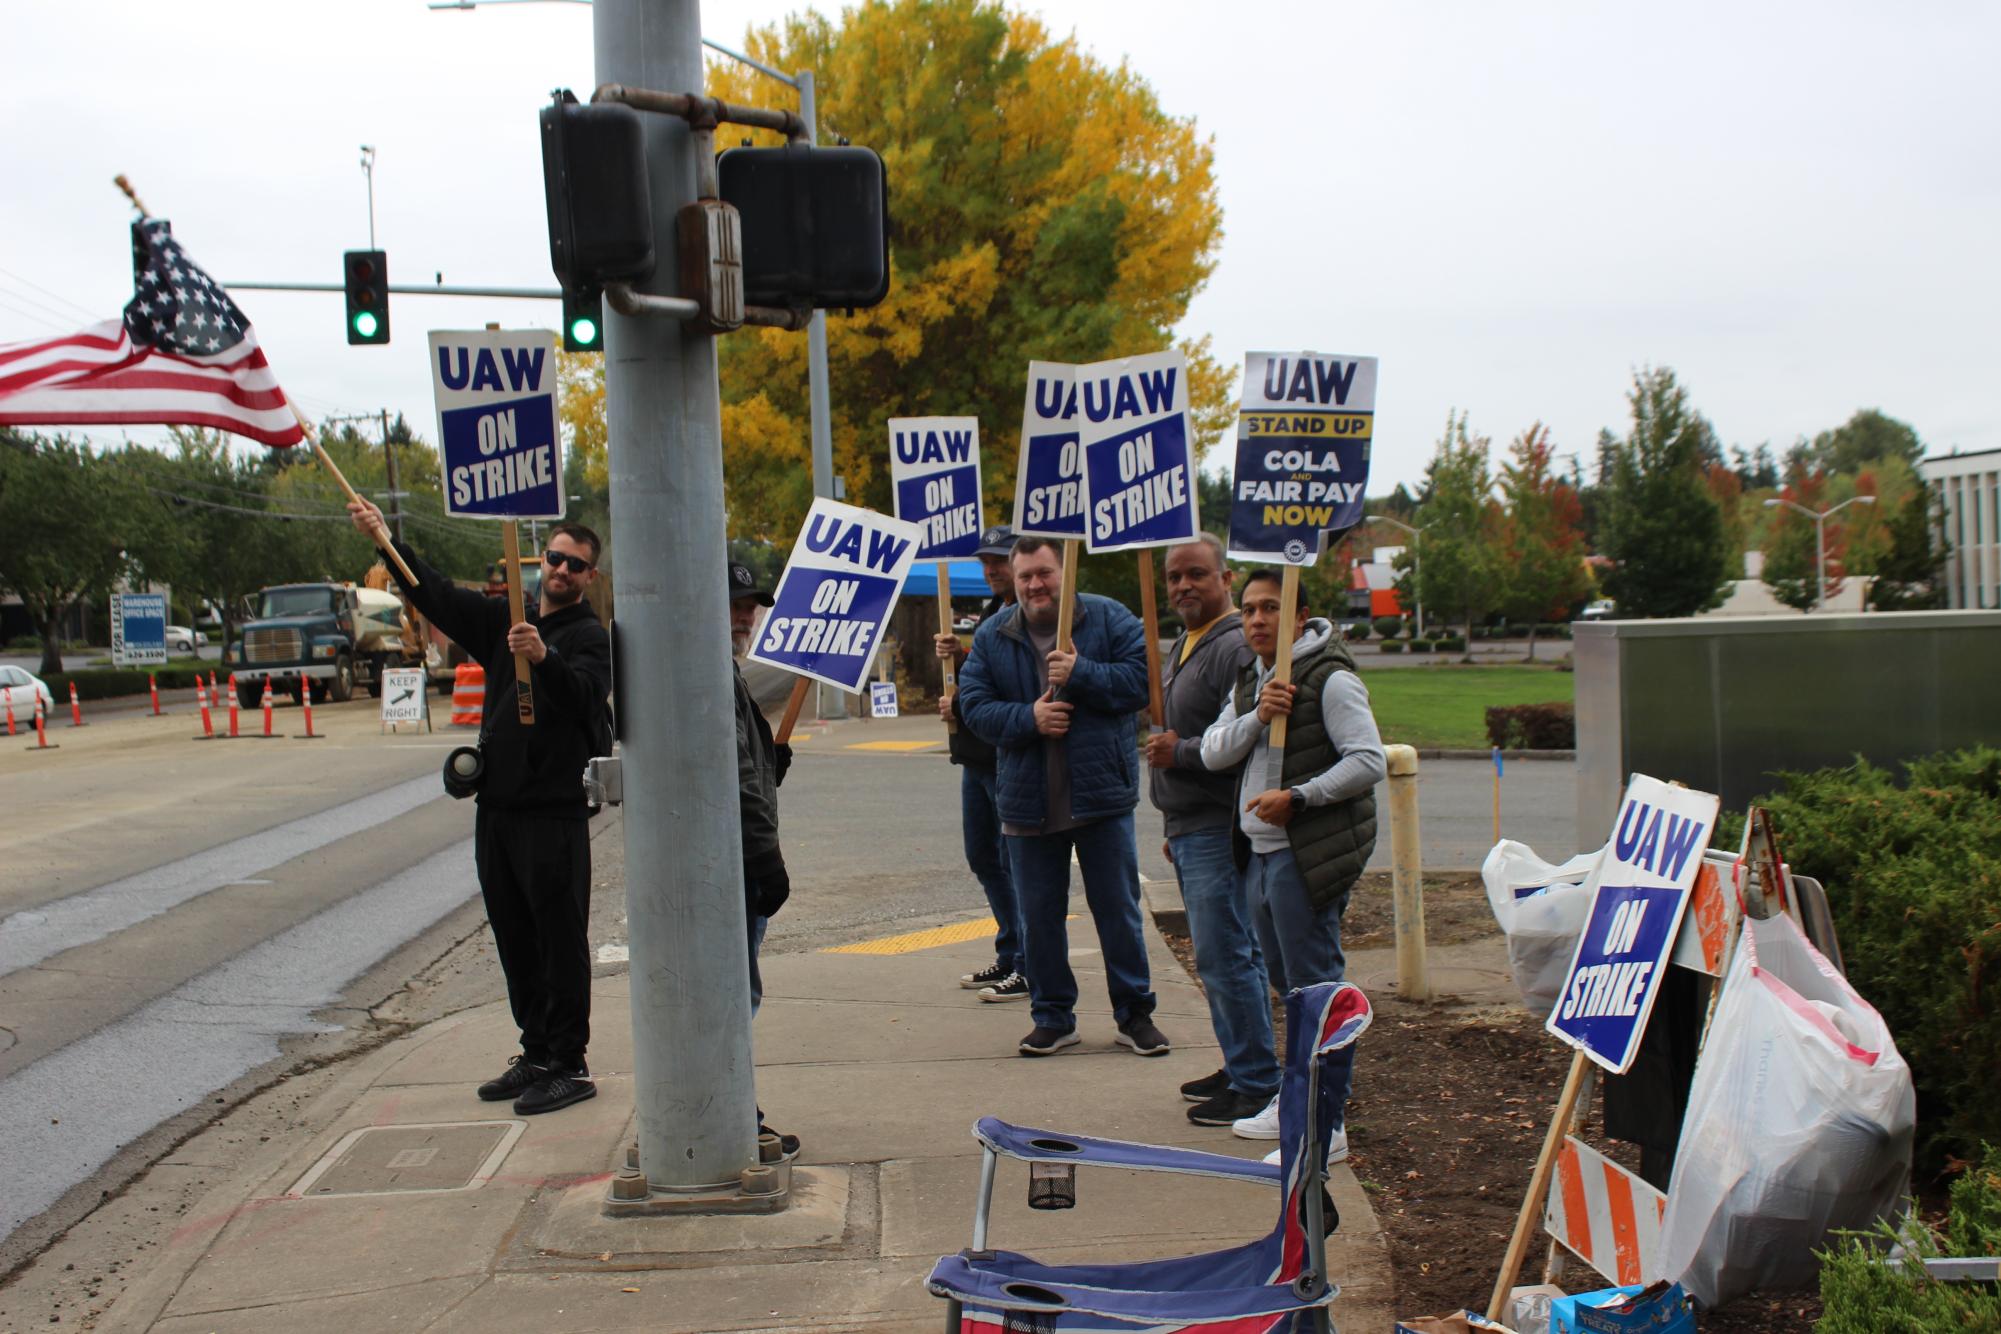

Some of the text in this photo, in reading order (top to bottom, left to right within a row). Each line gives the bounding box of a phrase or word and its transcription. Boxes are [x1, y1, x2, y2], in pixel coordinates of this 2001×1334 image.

[438, 346, 546, 392] UAW
[1264, 358, 1358, 405] UAW
[1035, 378, 1078, 419] UA
[1083, 367, 1177, 423] UAW
[477, 408, 517, 456] ON
[1248, 417, 1366, 434] STAND UP
[896, 430, 972, 464] UAW
[1058, 440, 1082, 479] O
[1118, 431, 1155, 483] ON
[1264, 450, 1341, 473] COLA
[452, 444, 552, 507] STRIKE
[925, 475, 954, 512] ON
[1239, 480, 1363, 503] FAIR PAY
[1290, 472, 1312, 481] AND
[1027, 479, 1084, 525] STRI
[1094, 463, 1187, 541] STRIKE
[1263, 505, 1334, 526] NOW
[805, 513, 911, 575] UAW
[917, 502, 977, 550] TRIKE
[112, 595, 121, 629] LEASE
[810, 578, 860, 615] ON
[113, 632, 122, 653] FOR
[762, 617, 876, 657] STRIKE
[389, 676, 417, 686] KEEP
[385, 708, 417, 718] RIGHT
[875, 706, 896, 714] UAW
[1615, 799, 1705, 882] UAW
[1603, 898, 1649, 956] ON
[1562, 961, 1653, 1021] STRIKE
